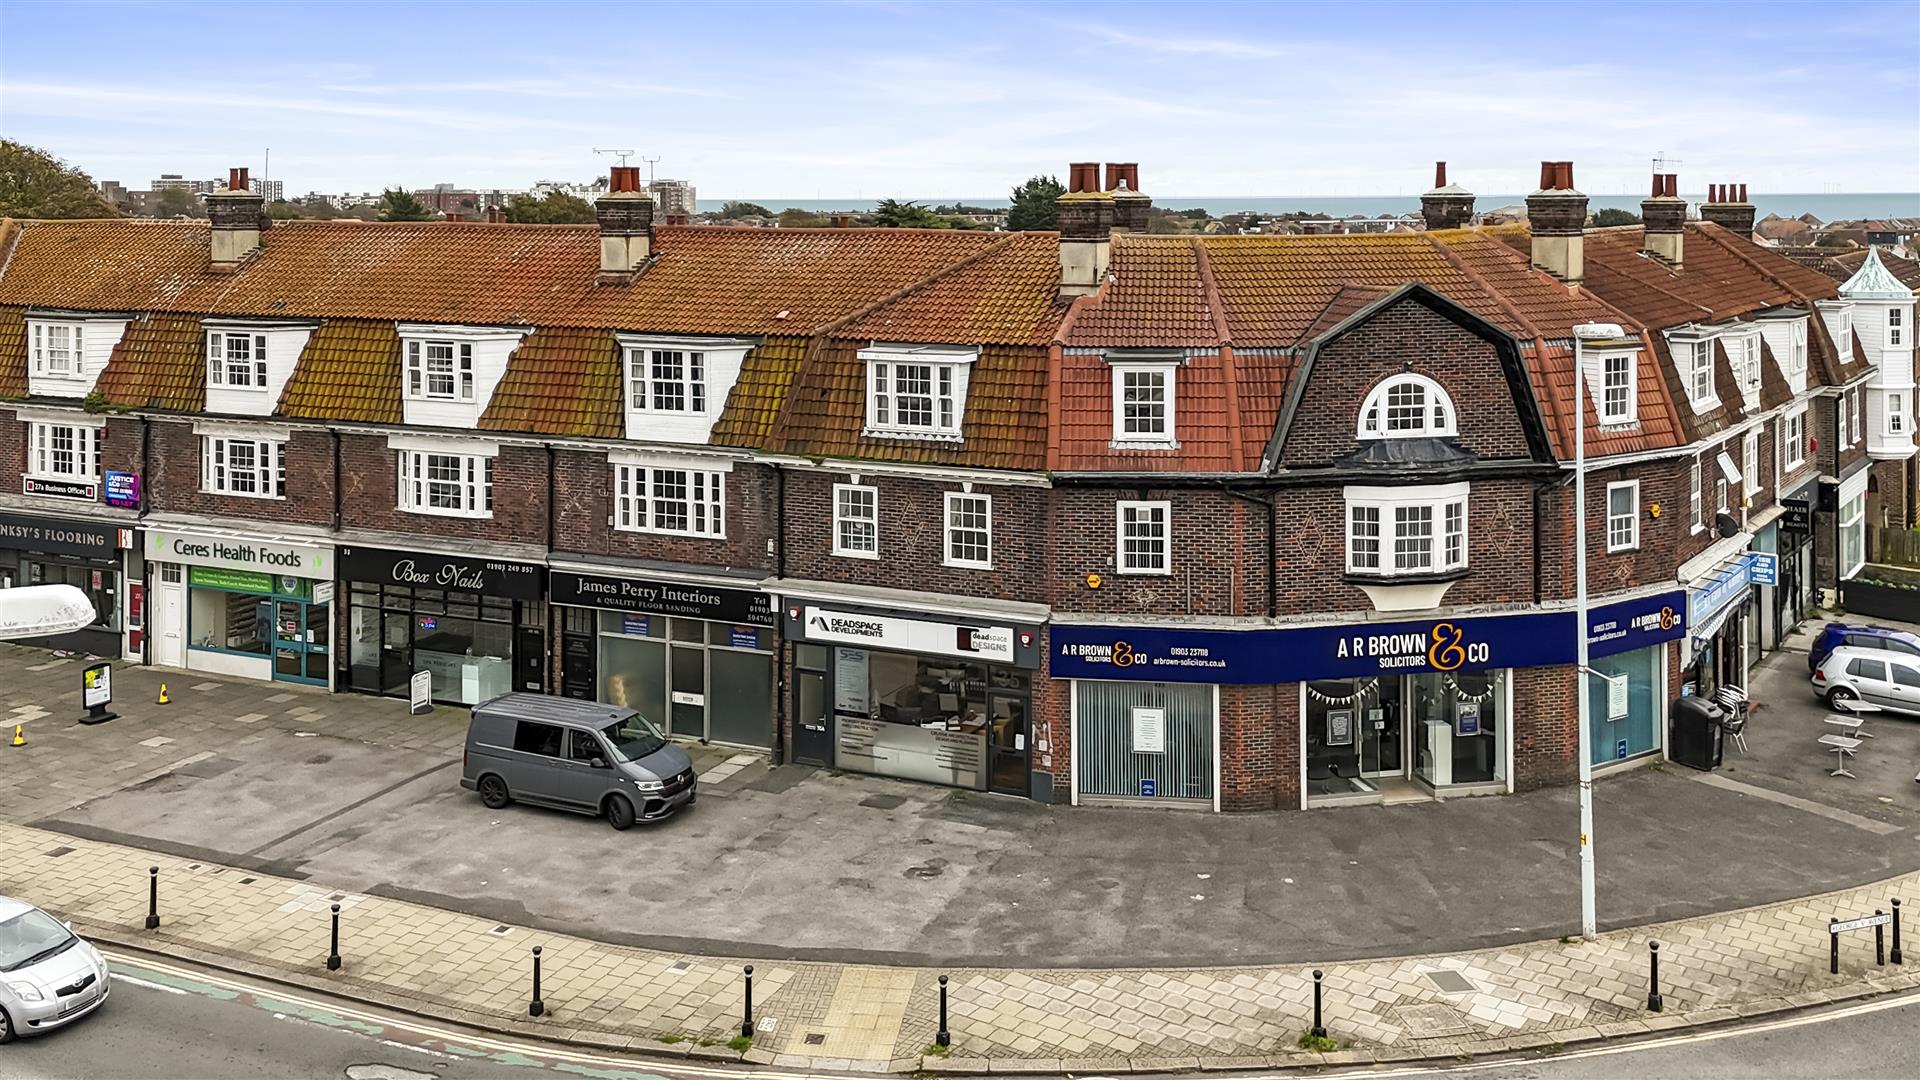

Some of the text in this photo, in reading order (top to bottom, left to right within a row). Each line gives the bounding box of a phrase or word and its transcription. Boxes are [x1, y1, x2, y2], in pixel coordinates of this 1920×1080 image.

[45, 484, 66, 493] Business
[67, 486, 85, 496] Offices
[45, 529, 105, 546] FLOORING
[174, 539, 301, 567] Ceres Health Foods
[392, 559, 485, 589] Box Nails
[576, 577, 721, 606] James Perry Interiors
[604, 598, 636, 608] QUALITY
[638, 601, 664, 611] FLOOR
[666, 604, 701, 614] SANDING
[750, 605, 770, 614] 01903
[831, 618, 883, 631] DEADSPACE
[1631, 606, 1681, 630] A R BROWN & CO
[831, 626, 883, 637] DEVELOPMENTS
[972, 641, 1007, 652] DESIGNS
[1062, 641, 1147, 667] A R BROWN & CO
[1337, 623, 1489, 670] A R BROWN & CO
[1379, 655, 1426, 668] SOLICITORS
